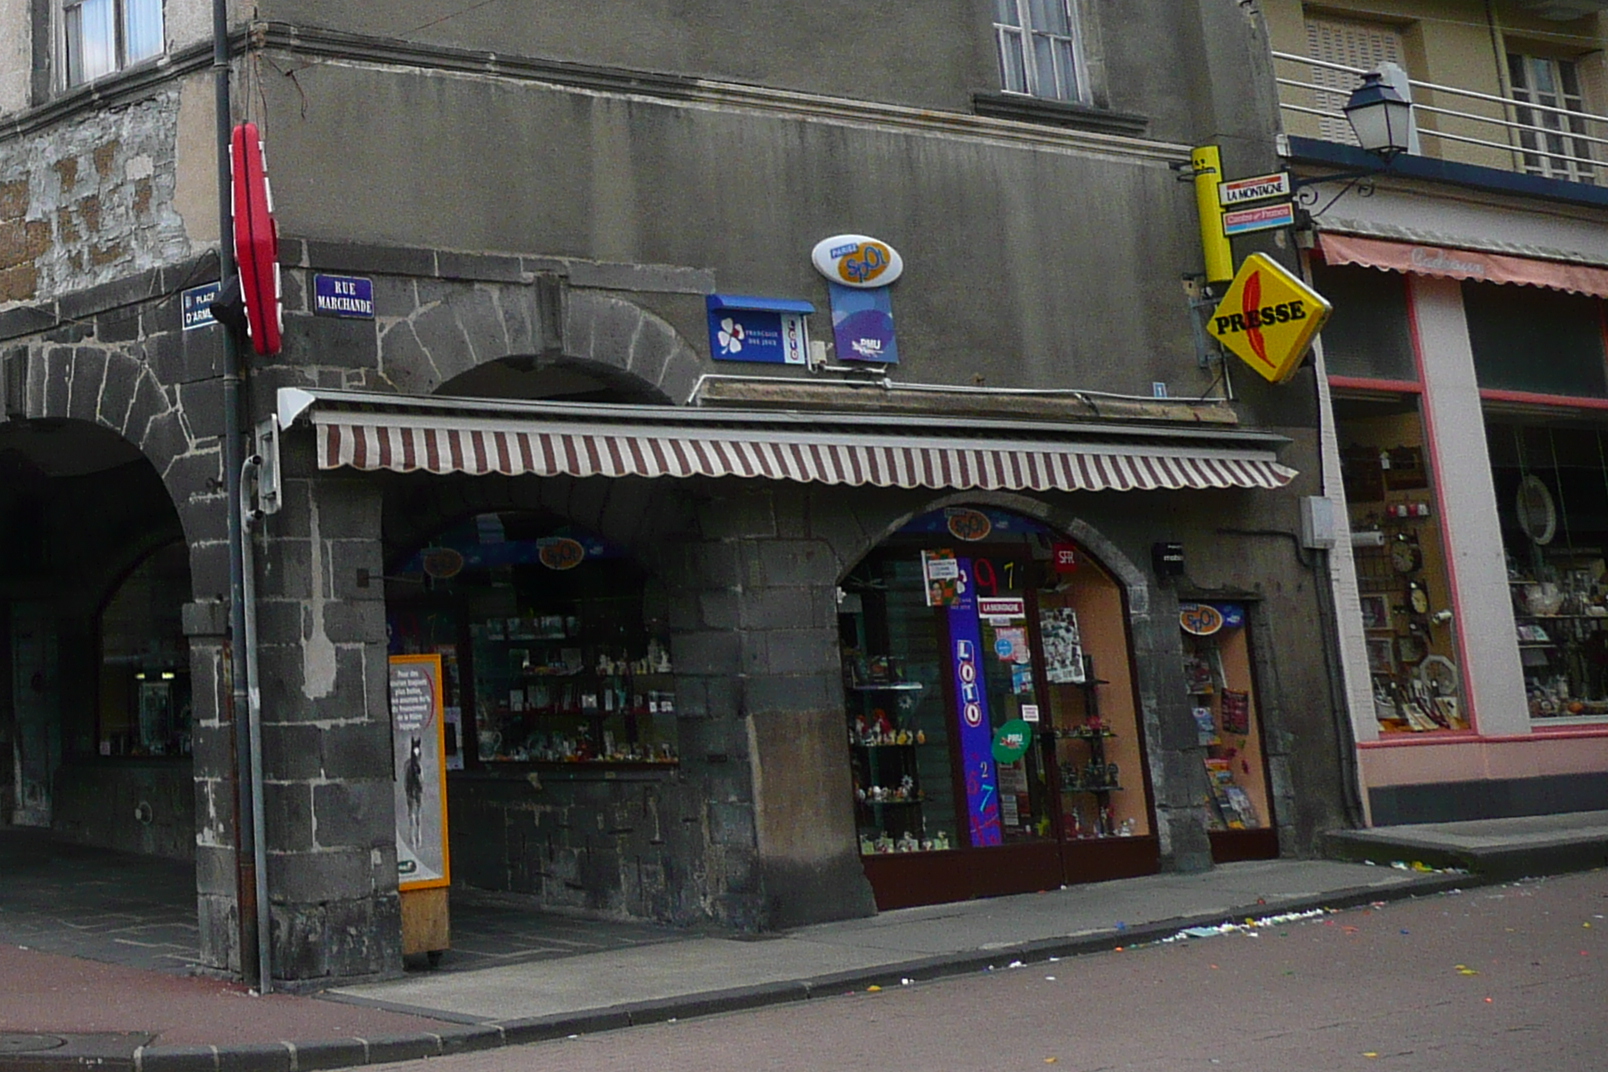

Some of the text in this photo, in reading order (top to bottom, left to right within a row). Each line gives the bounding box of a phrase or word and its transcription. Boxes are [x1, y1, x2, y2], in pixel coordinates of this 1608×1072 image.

[1227, 190, 1238, 201] LA
[1239, 182, 1284, 200] MONTAGNE
[334, 280, 357, 296] RUE
[195, 292, 215, 305] PLACE
[317, 295, 372, 314] MARCHANDE
[185, 307, 214, 324] D'ARME
[1215, 300, 1307, 335] PRESSE
[1058, 550, 1075, 564] SFR
[957, 640, 982, 728] LOTO
